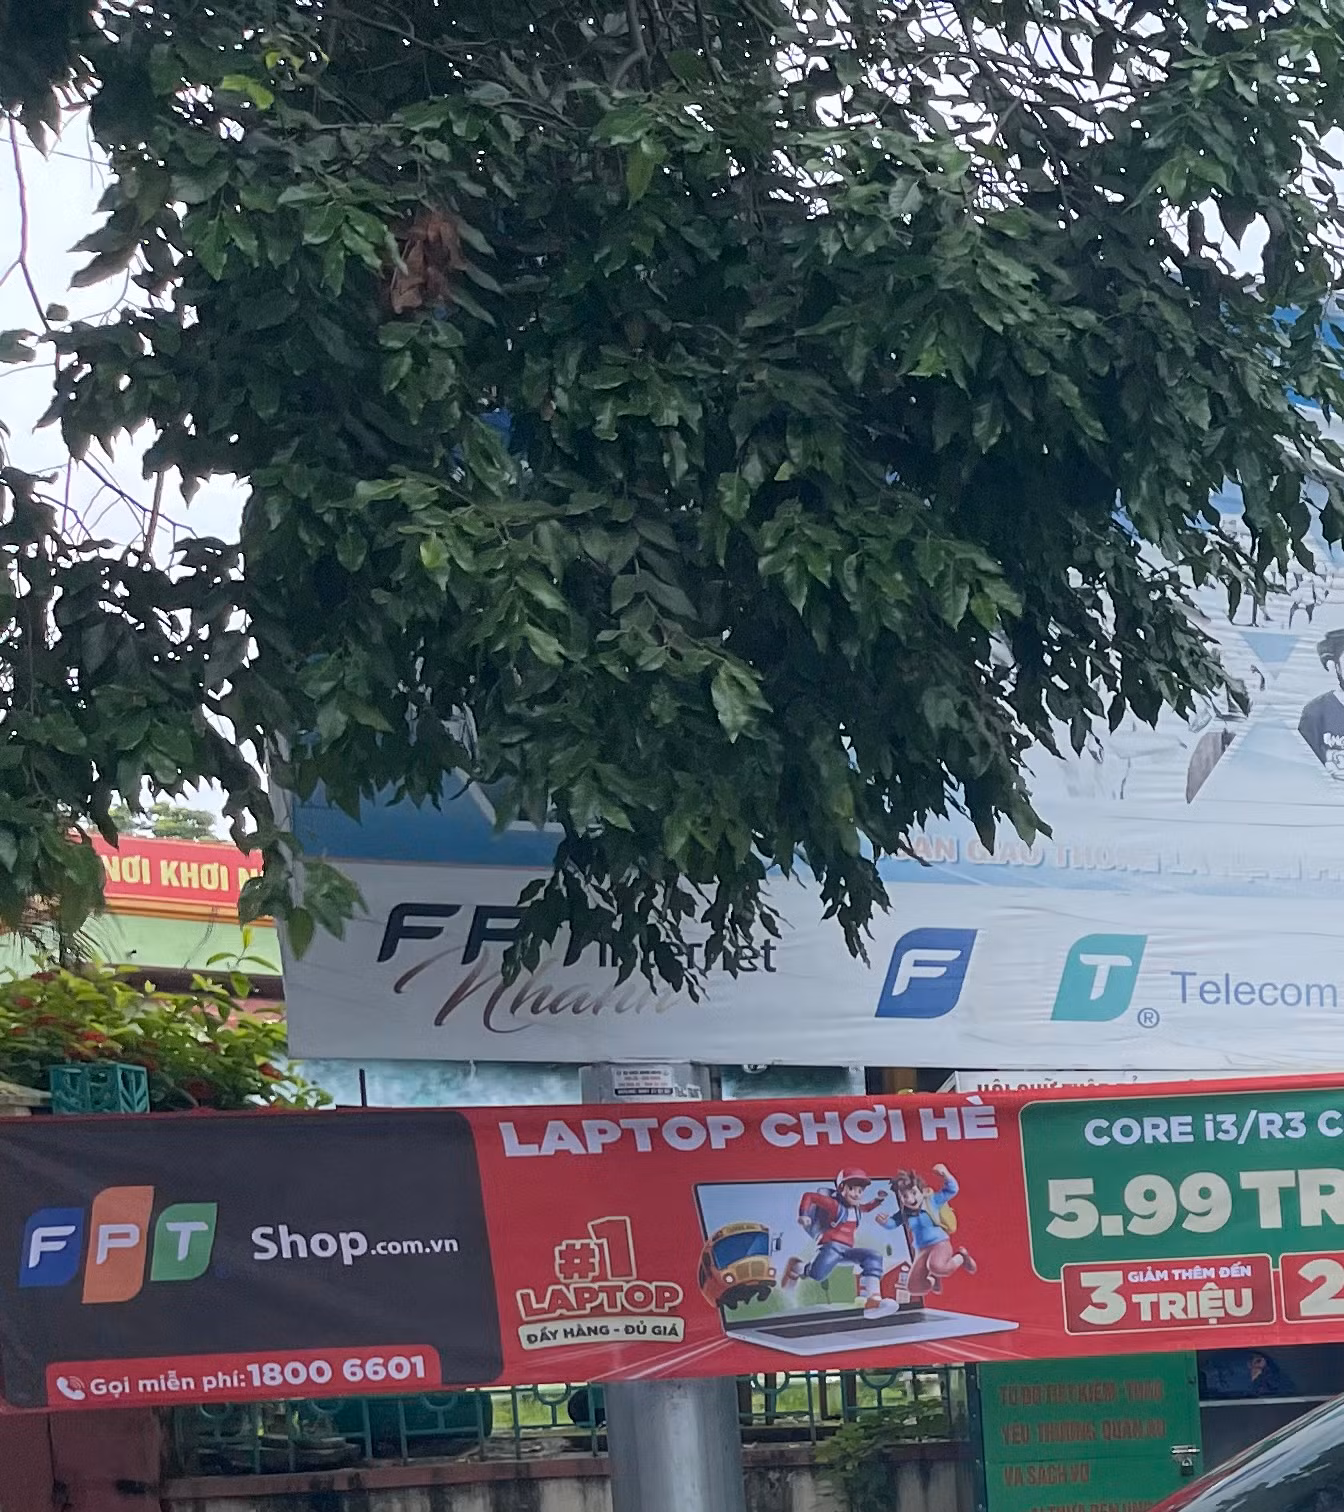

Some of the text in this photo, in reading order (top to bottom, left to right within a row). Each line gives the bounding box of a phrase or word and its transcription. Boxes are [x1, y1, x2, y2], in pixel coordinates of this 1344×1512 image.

[160, 860, 229, 891] KHƠI
[1170, 970, 1338, 1009] Telecom
[499, 1095, 999, 1157] LAPTOP CHƠI HÈ
[1084, 1116, 1194, 1146] CORE
[1205, 1110, 1306, 1145] i3/R3
[1046, 1171, 1233, 1240] 5.99
[251, 1224, 460, 1263] Shop.com.vn
[555, 1215, 637, 1283] #1
[1127, 1262, 1252, 1283] GIẢM THÊM ĐẾN
[516, 1281, 683, 1322] LAPTOP
[1079, 1270, 1253, 1325] 3 TRIỆU
[563, 1323, 611, 1339] HÀNG
[624, 1320, 647, 1336] ĐỦ
[651, 1323, 679, 1337] GIÁ
[90, 1377, 130, 1398] Gọi
[138, 1371, 195, 1393] miễn
[342, 1355, 426, 1382] 6601
